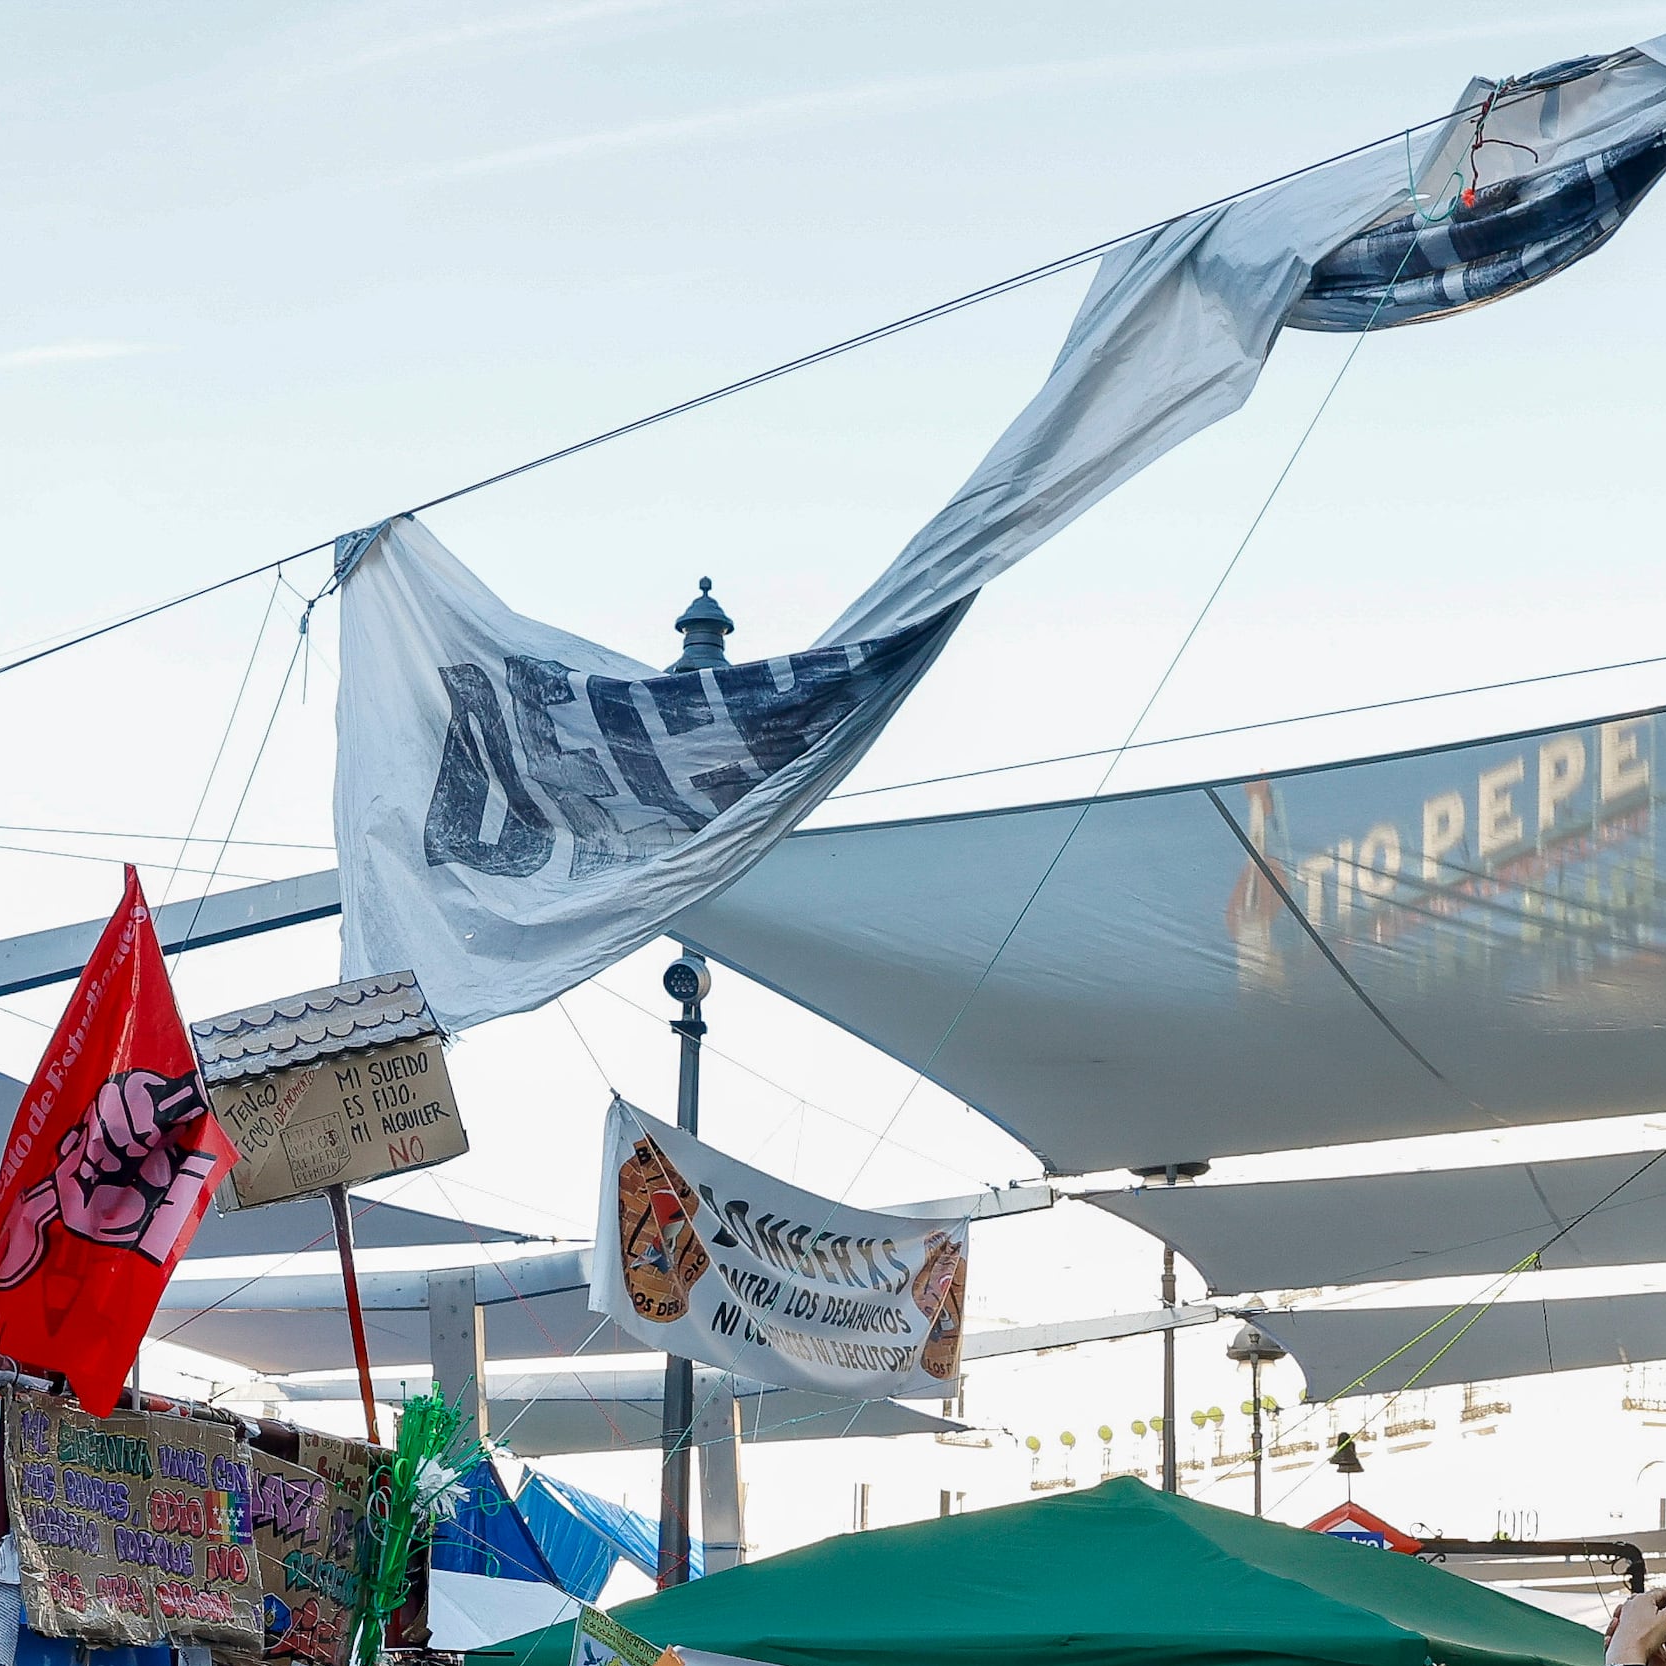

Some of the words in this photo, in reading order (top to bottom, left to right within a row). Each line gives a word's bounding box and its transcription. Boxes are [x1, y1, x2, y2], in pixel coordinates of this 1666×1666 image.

[1297, 822, 1403, 928] TIO
[1422, 716, 1652, 879] PEPE
[334, 1067, 362, 1092] MI
[28, 1090, 56, 1137] de
[224, 1084, 278, 1132] TENGO
[343, 1095, 364, 1120] ES
[351, 1120, 372, 1144] MI
[383, 1101, 450, 1134] ALQUILER
[387, 1135, 425, 1168] NO
[711, 1301, 743, 1335] NI
[786, 1287, 819, 1319] LOS
[821, 1293, 912, 1334] DESAHUCIOS
[58, 1418, 154, 1480] ENCANTA
[212, 1454, 251, 1492] CON
[22, 1462, 55, 1502] MIS
[150, 1488, 207, 1539] ODIO
[114, 1525, 196, 1578] PORQUE
[206, 1544, 250, 1585] NO
